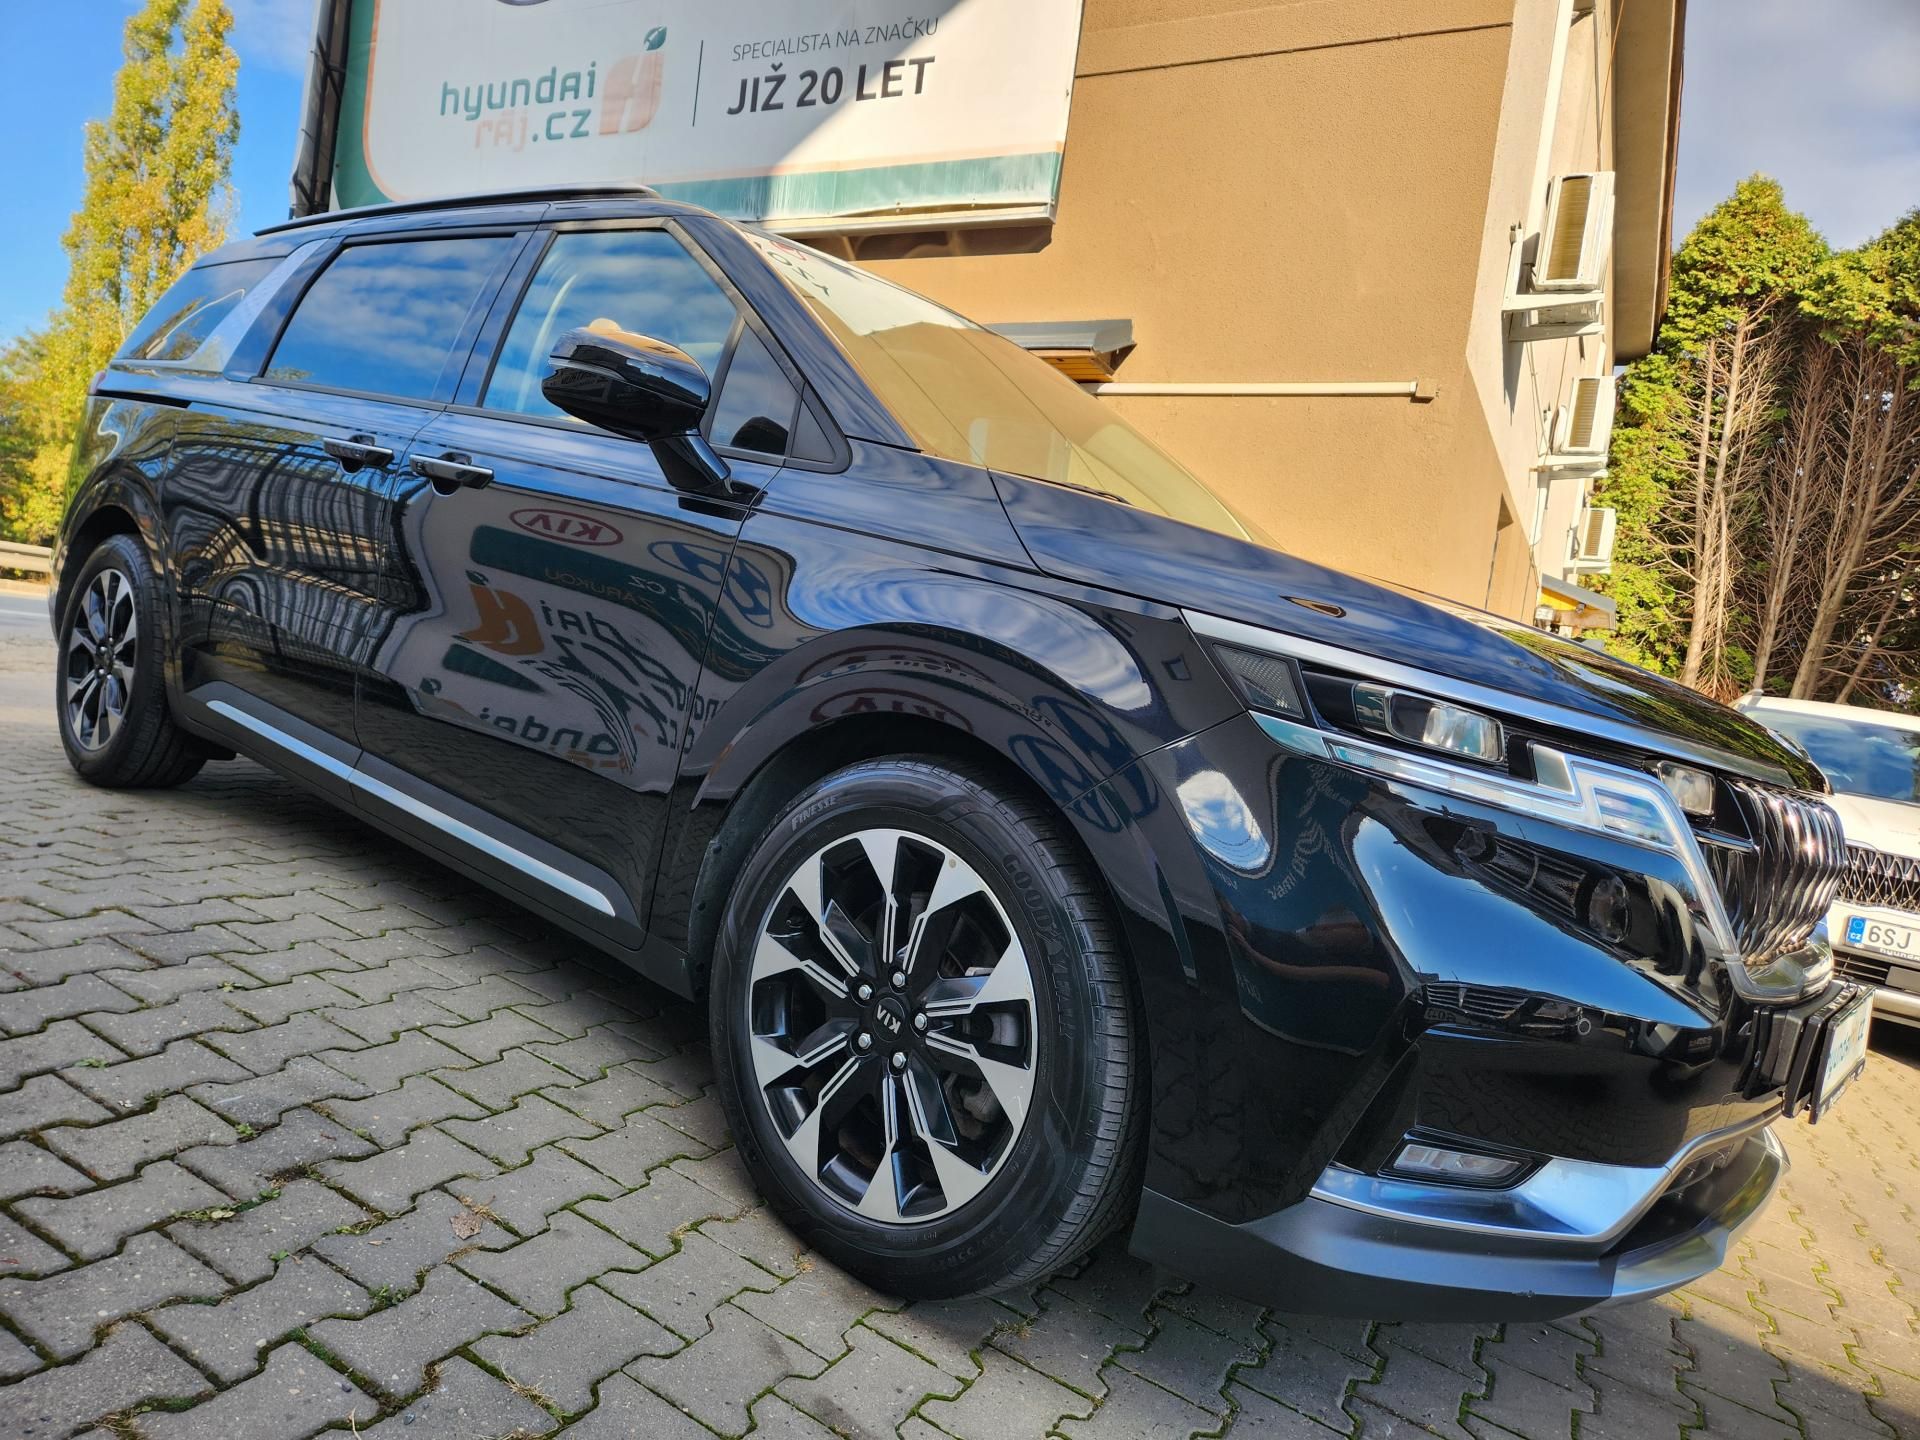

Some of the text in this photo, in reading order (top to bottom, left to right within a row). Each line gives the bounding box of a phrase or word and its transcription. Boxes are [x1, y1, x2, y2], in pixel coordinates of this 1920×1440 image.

[732, 17, 939, 62] SPECIALISTA NA ZNAČKU
[727, 56, 936, 115] JIŽ 20 LET
[876, 1004, 902, 1034] KIA
